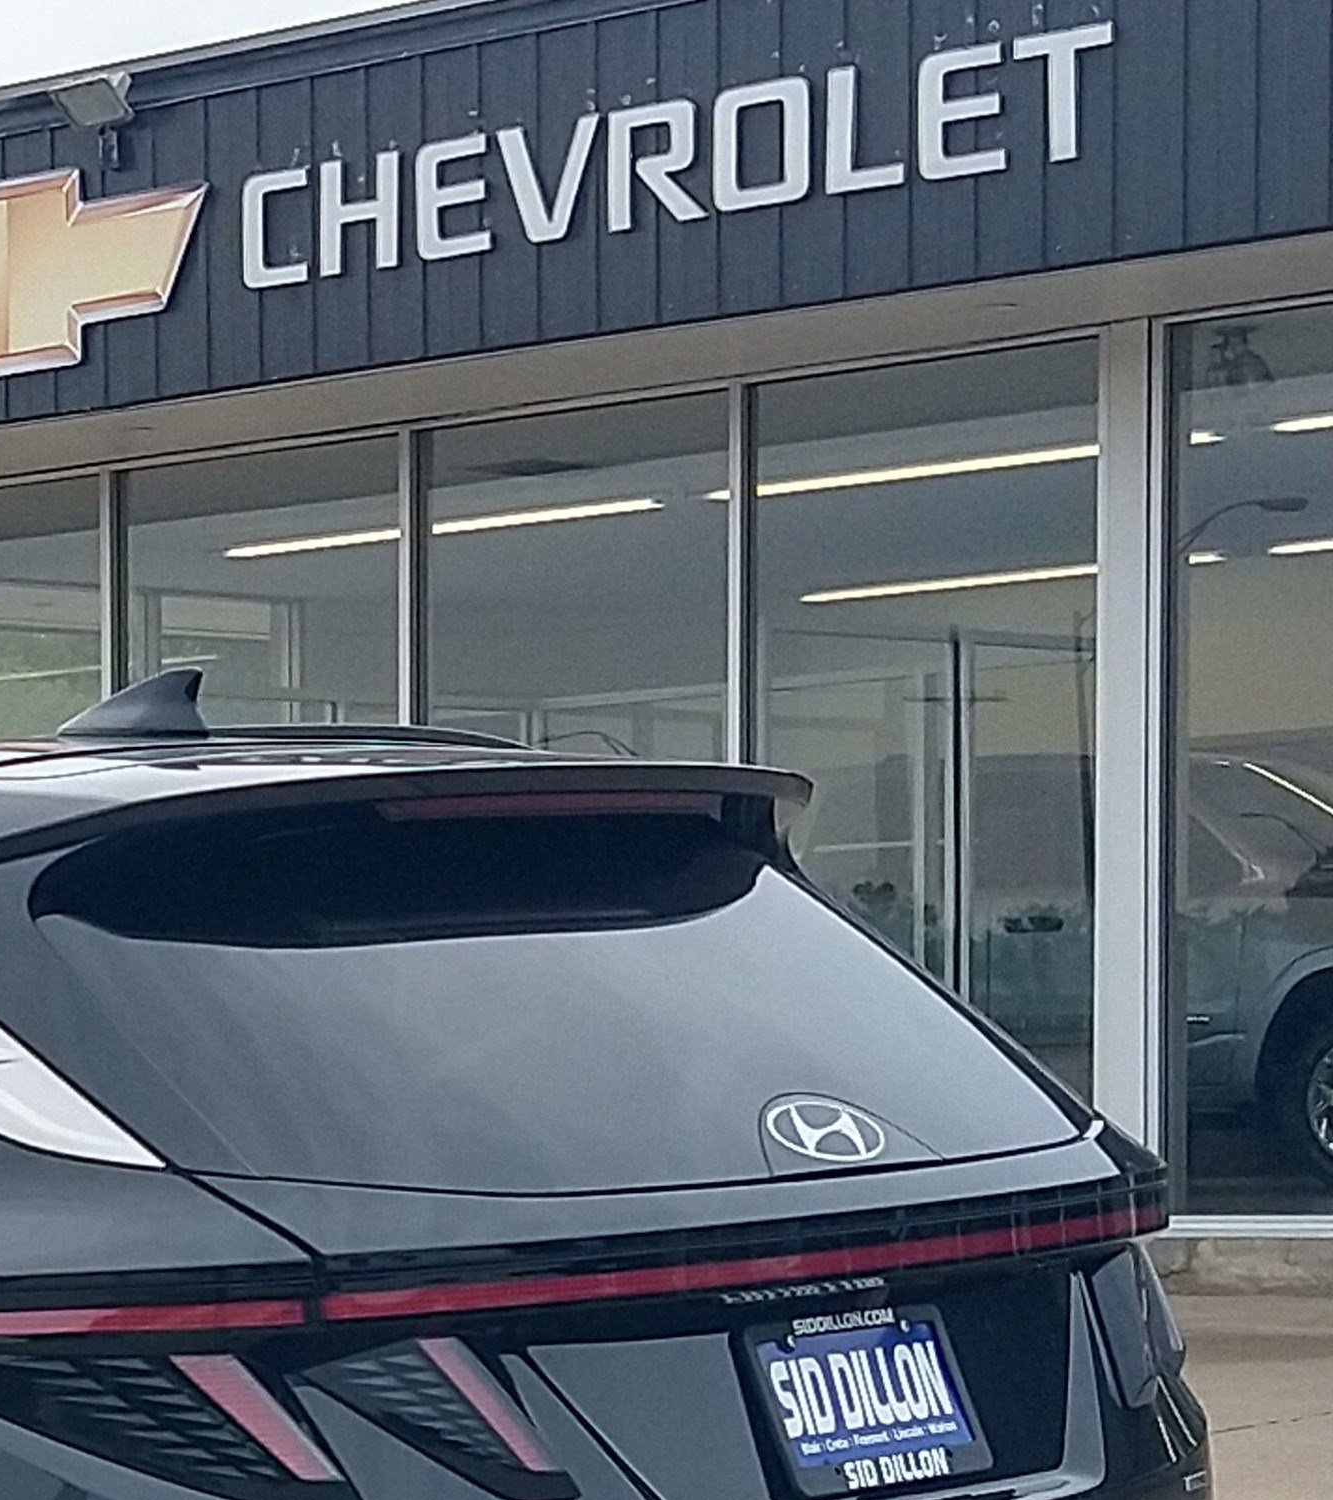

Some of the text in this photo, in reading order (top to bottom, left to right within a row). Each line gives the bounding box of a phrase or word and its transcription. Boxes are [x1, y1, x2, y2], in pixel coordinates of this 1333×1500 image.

[241, 20, 1116, 291] CHEVROLET
[769, 1356, 835, 1439] SID
[827, 1340, 954, 1431] DILLON
[843, 1447, 950, 1490] SID DILLON
